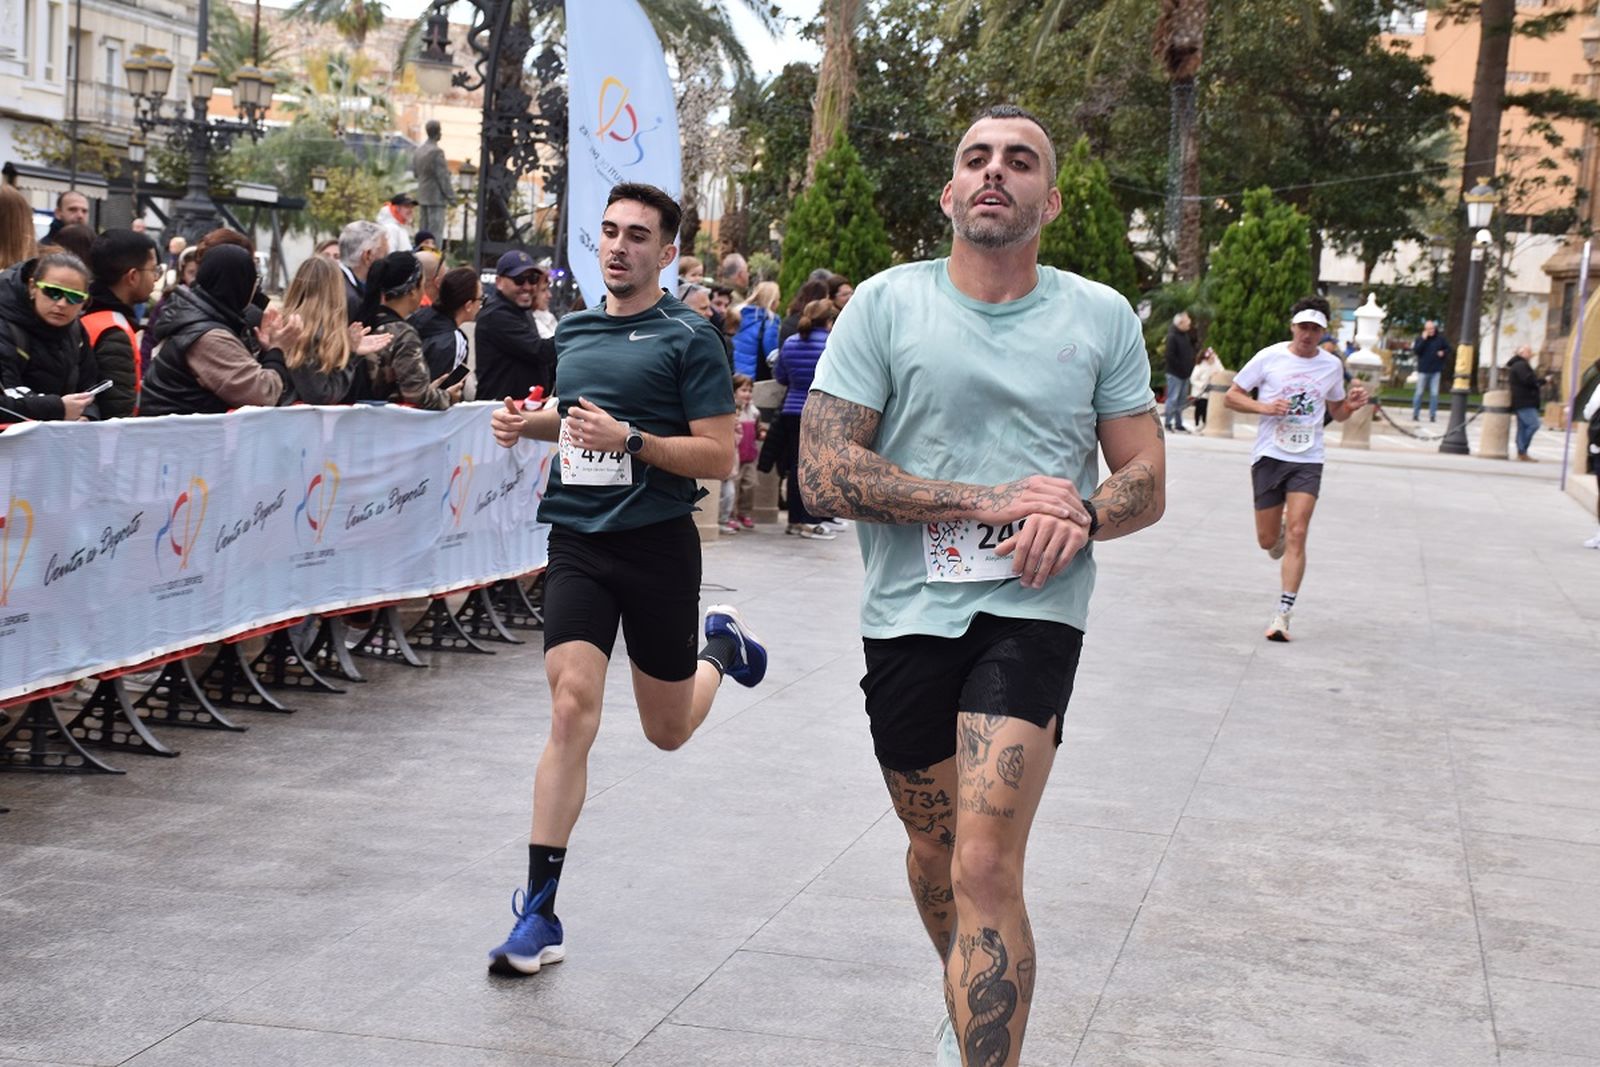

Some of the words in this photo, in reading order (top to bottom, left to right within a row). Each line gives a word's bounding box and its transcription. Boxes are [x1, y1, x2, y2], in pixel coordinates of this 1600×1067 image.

[1290, 434, 1310, 443] 413
[345, 502, 374, 530] Ceuta
[214, 519, 243, 553] Ceuta
[44, 546, 87, 586] Ceuta
[903, 788, 951, 809] 734
